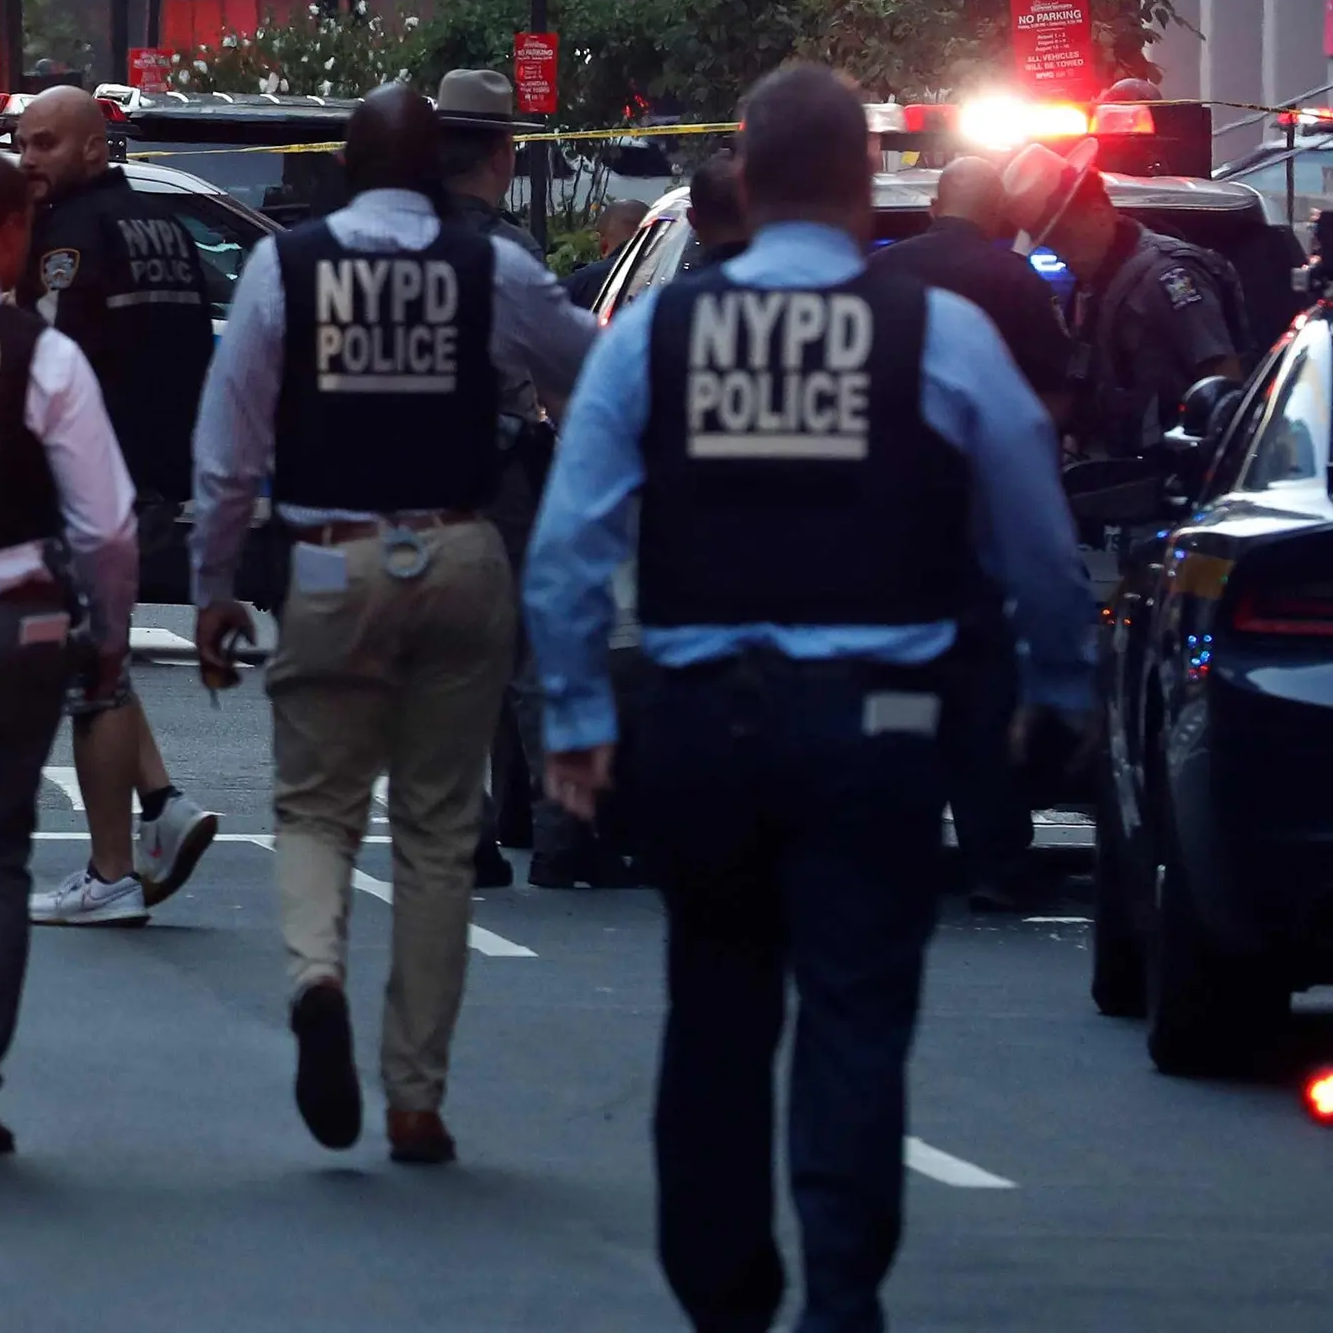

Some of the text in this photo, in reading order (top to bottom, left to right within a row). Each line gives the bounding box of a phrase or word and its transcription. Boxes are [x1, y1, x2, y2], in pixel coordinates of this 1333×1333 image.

[1018, 15, 1034, 25] NO
[1036, 9, 1082, 23] PARKING
[1042, 51, 1080, 61] VEHICLES
[317, 259, 458, 324] NYPD
[317, 324, 458, 373] POLICE
[690, 292, 873, 370] NYPD
[687, 369, 871, 432] POLICE
